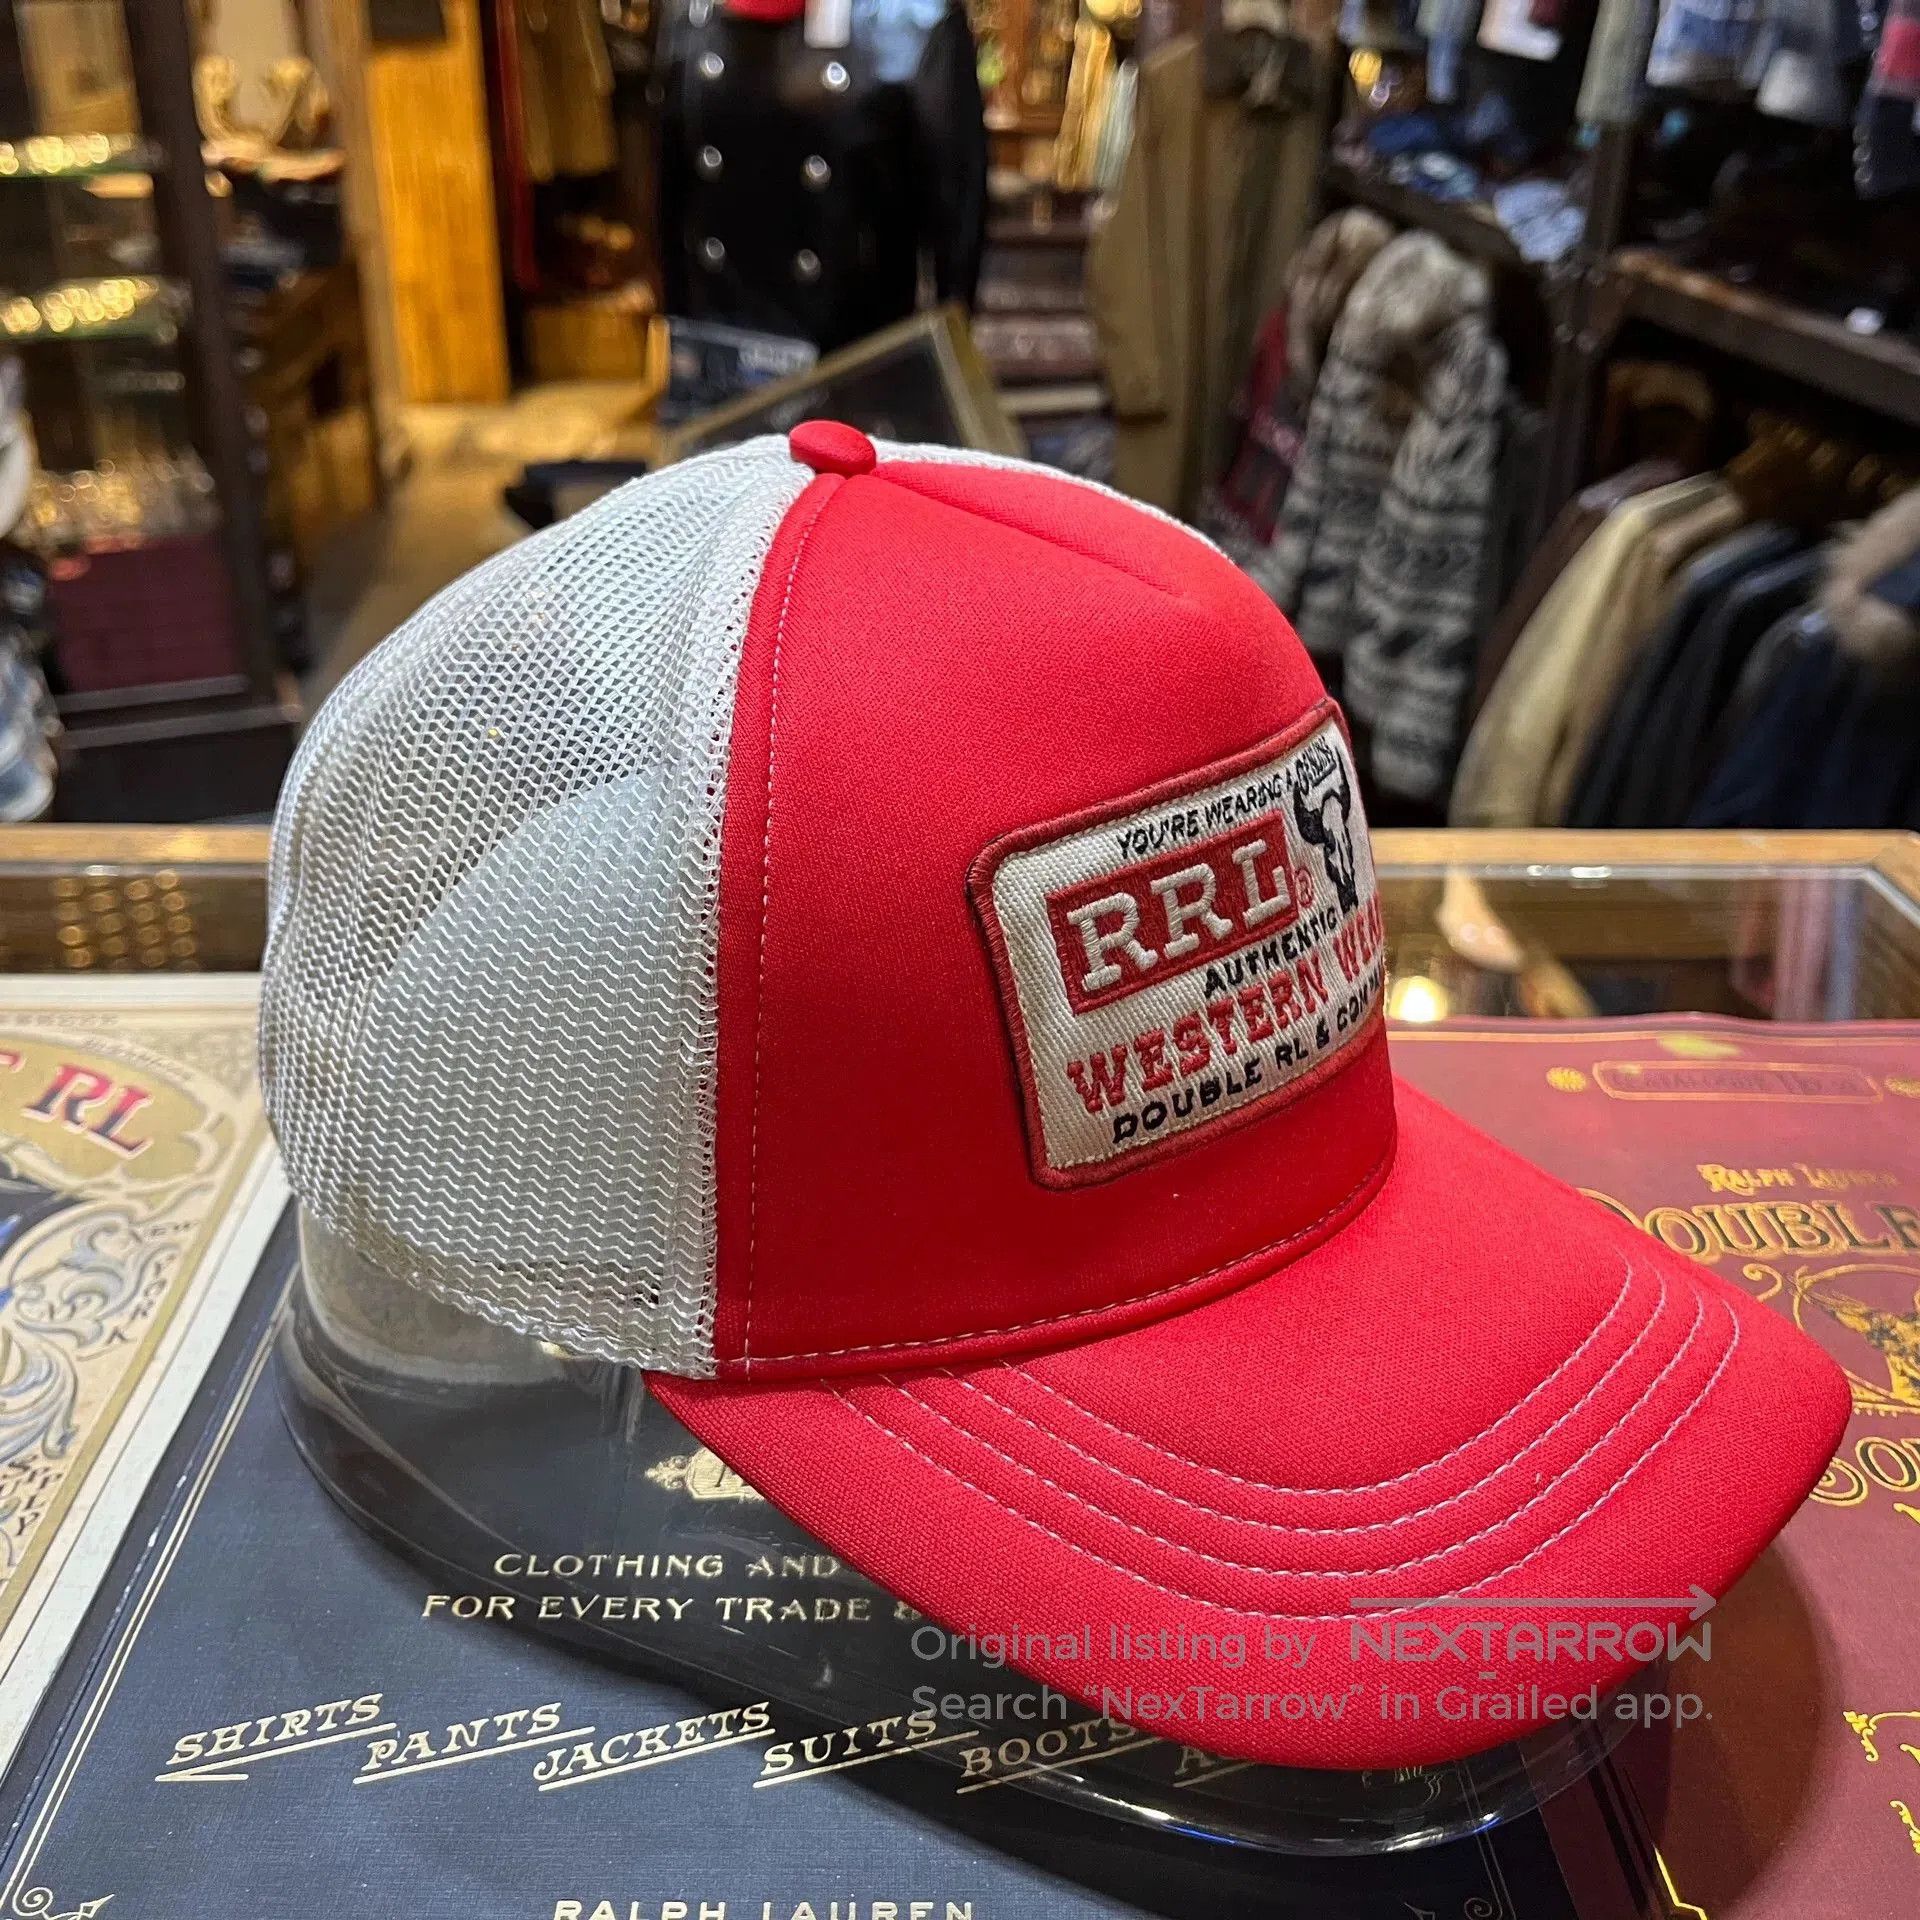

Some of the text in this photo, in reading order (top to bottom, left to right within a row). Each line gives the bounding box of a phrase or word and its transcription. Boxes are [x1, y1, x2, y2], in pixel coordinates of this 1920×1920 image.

[1117, 809, 1201, 859] YOU'RE
[1205, 773, 1283, 828] WEARING
[1067, 839, 1292, 992] RRL
[1204, 906, 1338, 998] AUTHENTIC
[1067, 949, 1328, 1113] WESTERN
[20, 1063, 154, 1160] RL
[1112, 1053, 1262, 1144] DOUBLE
[1275, 1036, 1308, 1070] RL
[1315, 1017, 1330, 1049] &
[1575, 1186, 1920, 1258] OUBLE
[493, 1552, 840, 1578] CLOTHING AND
[421, 1594, 517, 1622] FOR
[537, 1594, 696, 1622] EVERY
[715, 1596, 872, 1622] TRADE
[165, 1693, 383, 1766] SHIRTS
[360, 1702, 562, 1771] PANTS
[533, 1701, 771, 1781] JACKETS
[760, 1705, 939, 1777] SUITS
[961, 1712, 1137, 1778] BOOTS
[553, 1900, 727, 1920] RALPH
